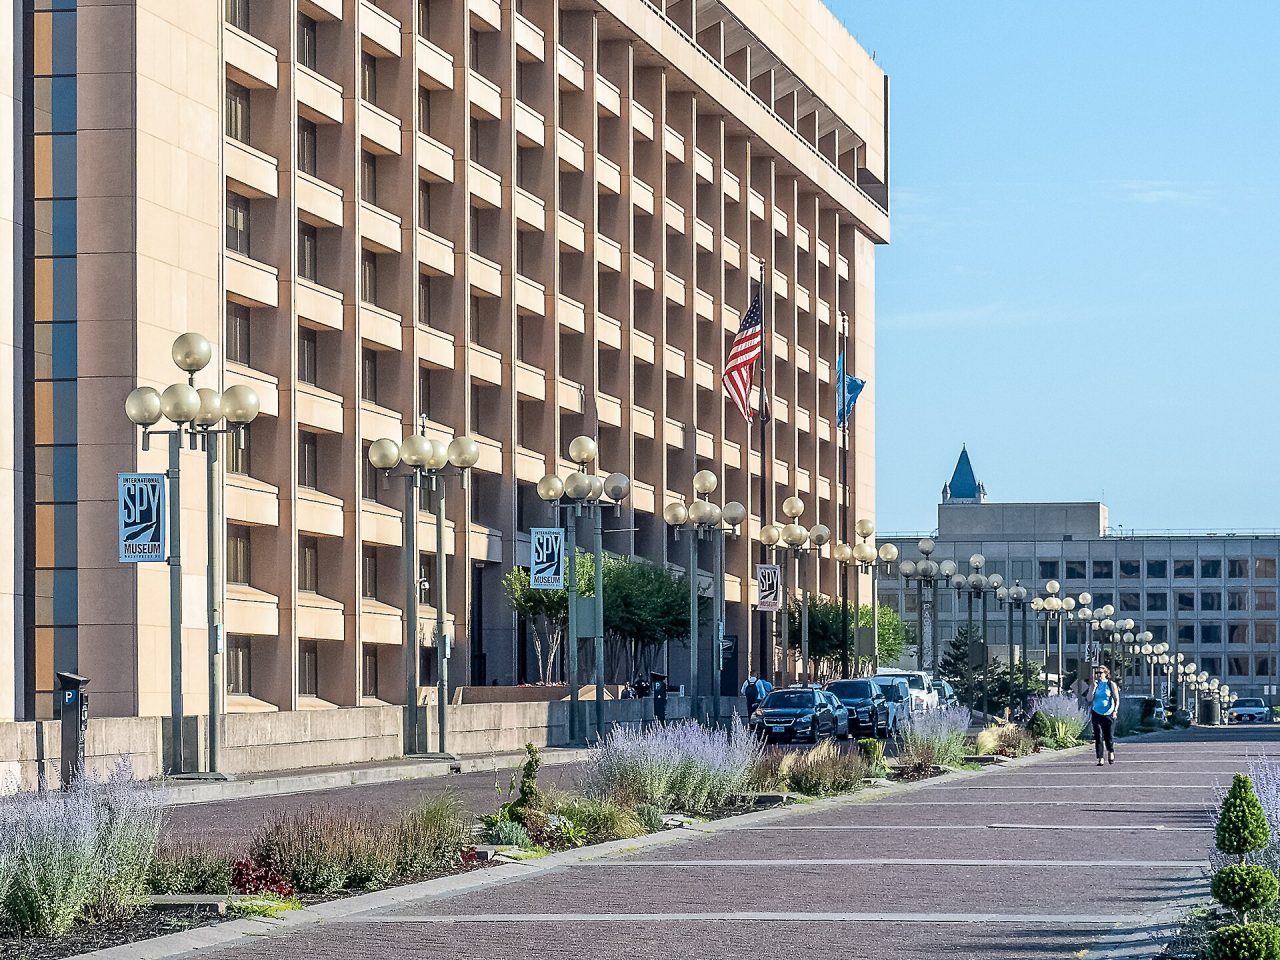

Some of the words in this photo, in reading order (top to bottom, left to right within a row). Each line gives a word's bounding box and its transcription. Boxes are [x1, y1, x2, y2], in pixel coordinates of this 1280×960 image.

[123, 484, 161, 523] SPY
[124, 543, 161, 555] MUSEUM
[535, 535, 561, 563] SPY
[534, 576, 561, 584] MUSEUM
[760, 569, 778, 591] SPY
[65, 691, 72, 702] P
